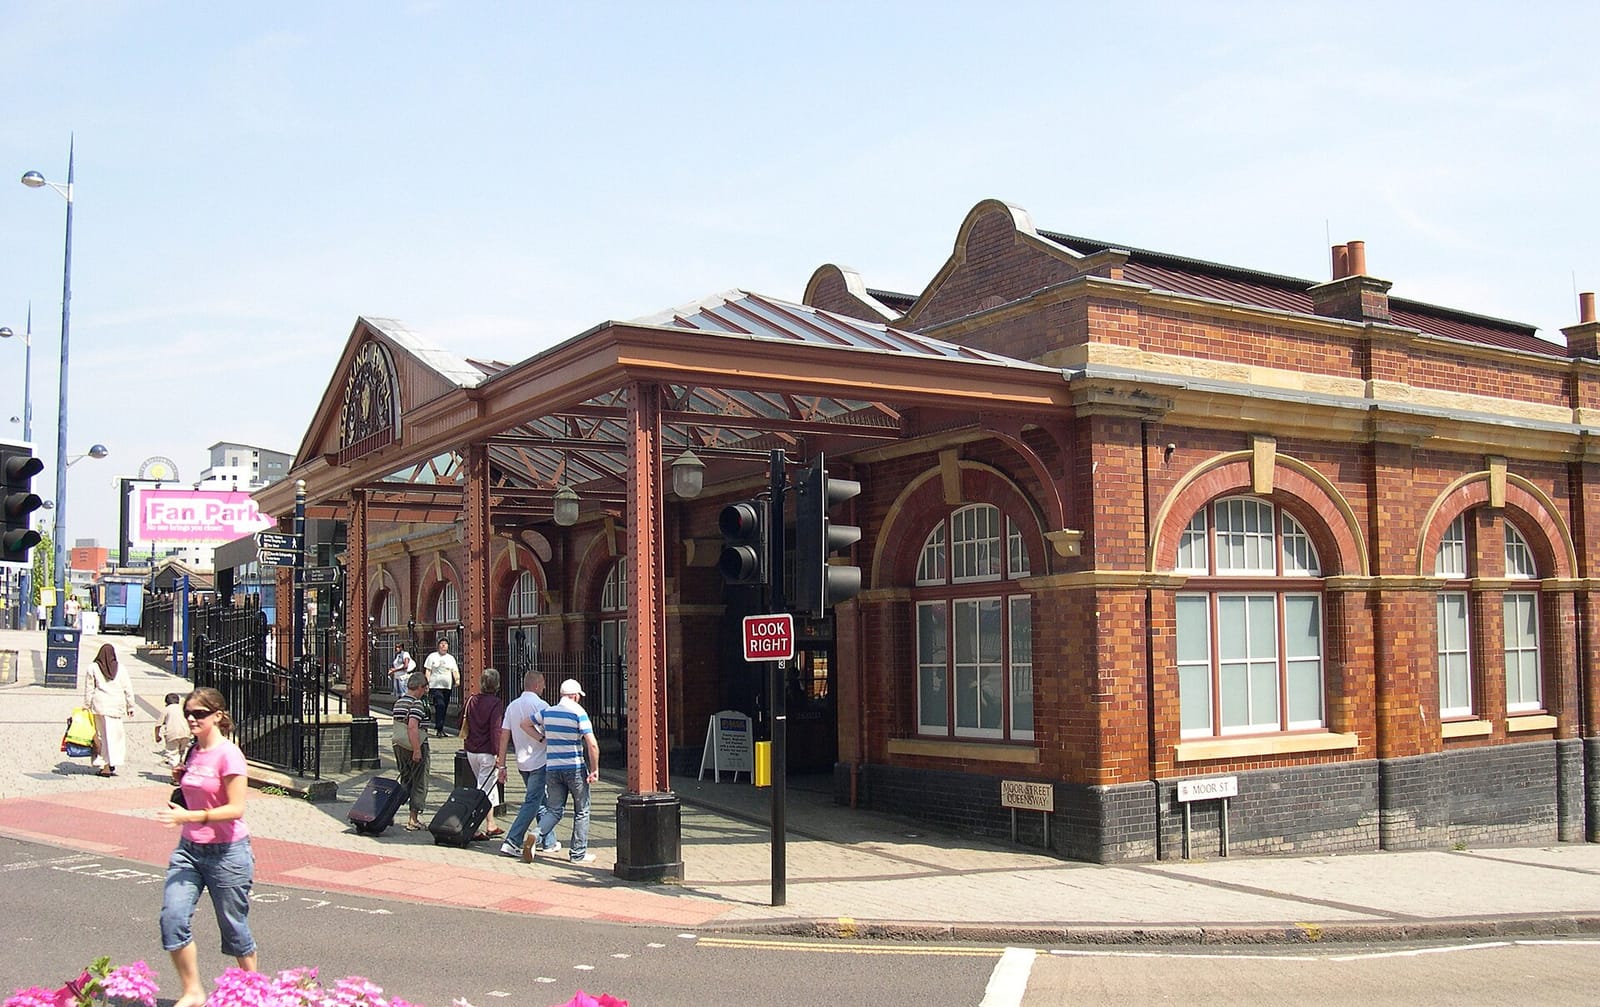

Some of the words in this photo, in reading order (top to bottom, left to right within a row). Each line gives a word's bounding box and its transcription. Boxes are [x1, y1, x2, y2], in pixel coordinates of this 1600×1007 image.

[340, 343, 368, 438] BOOKING
[150, 502, 196, 521] Fan
[205, 503, 260, 522] Park
[751, 622, 786, 637] LOOK
[750, 638, 788, 652] RIGHT
[1003, 783, 1024, 794] MOOR
[1024, 784, 1050, 797] STREET
[1193, 783, 1217, 795] MOOR
[1219, 781, 1228, 792] ST
[1007, 793, 1048, 807] QUEENSWAY
